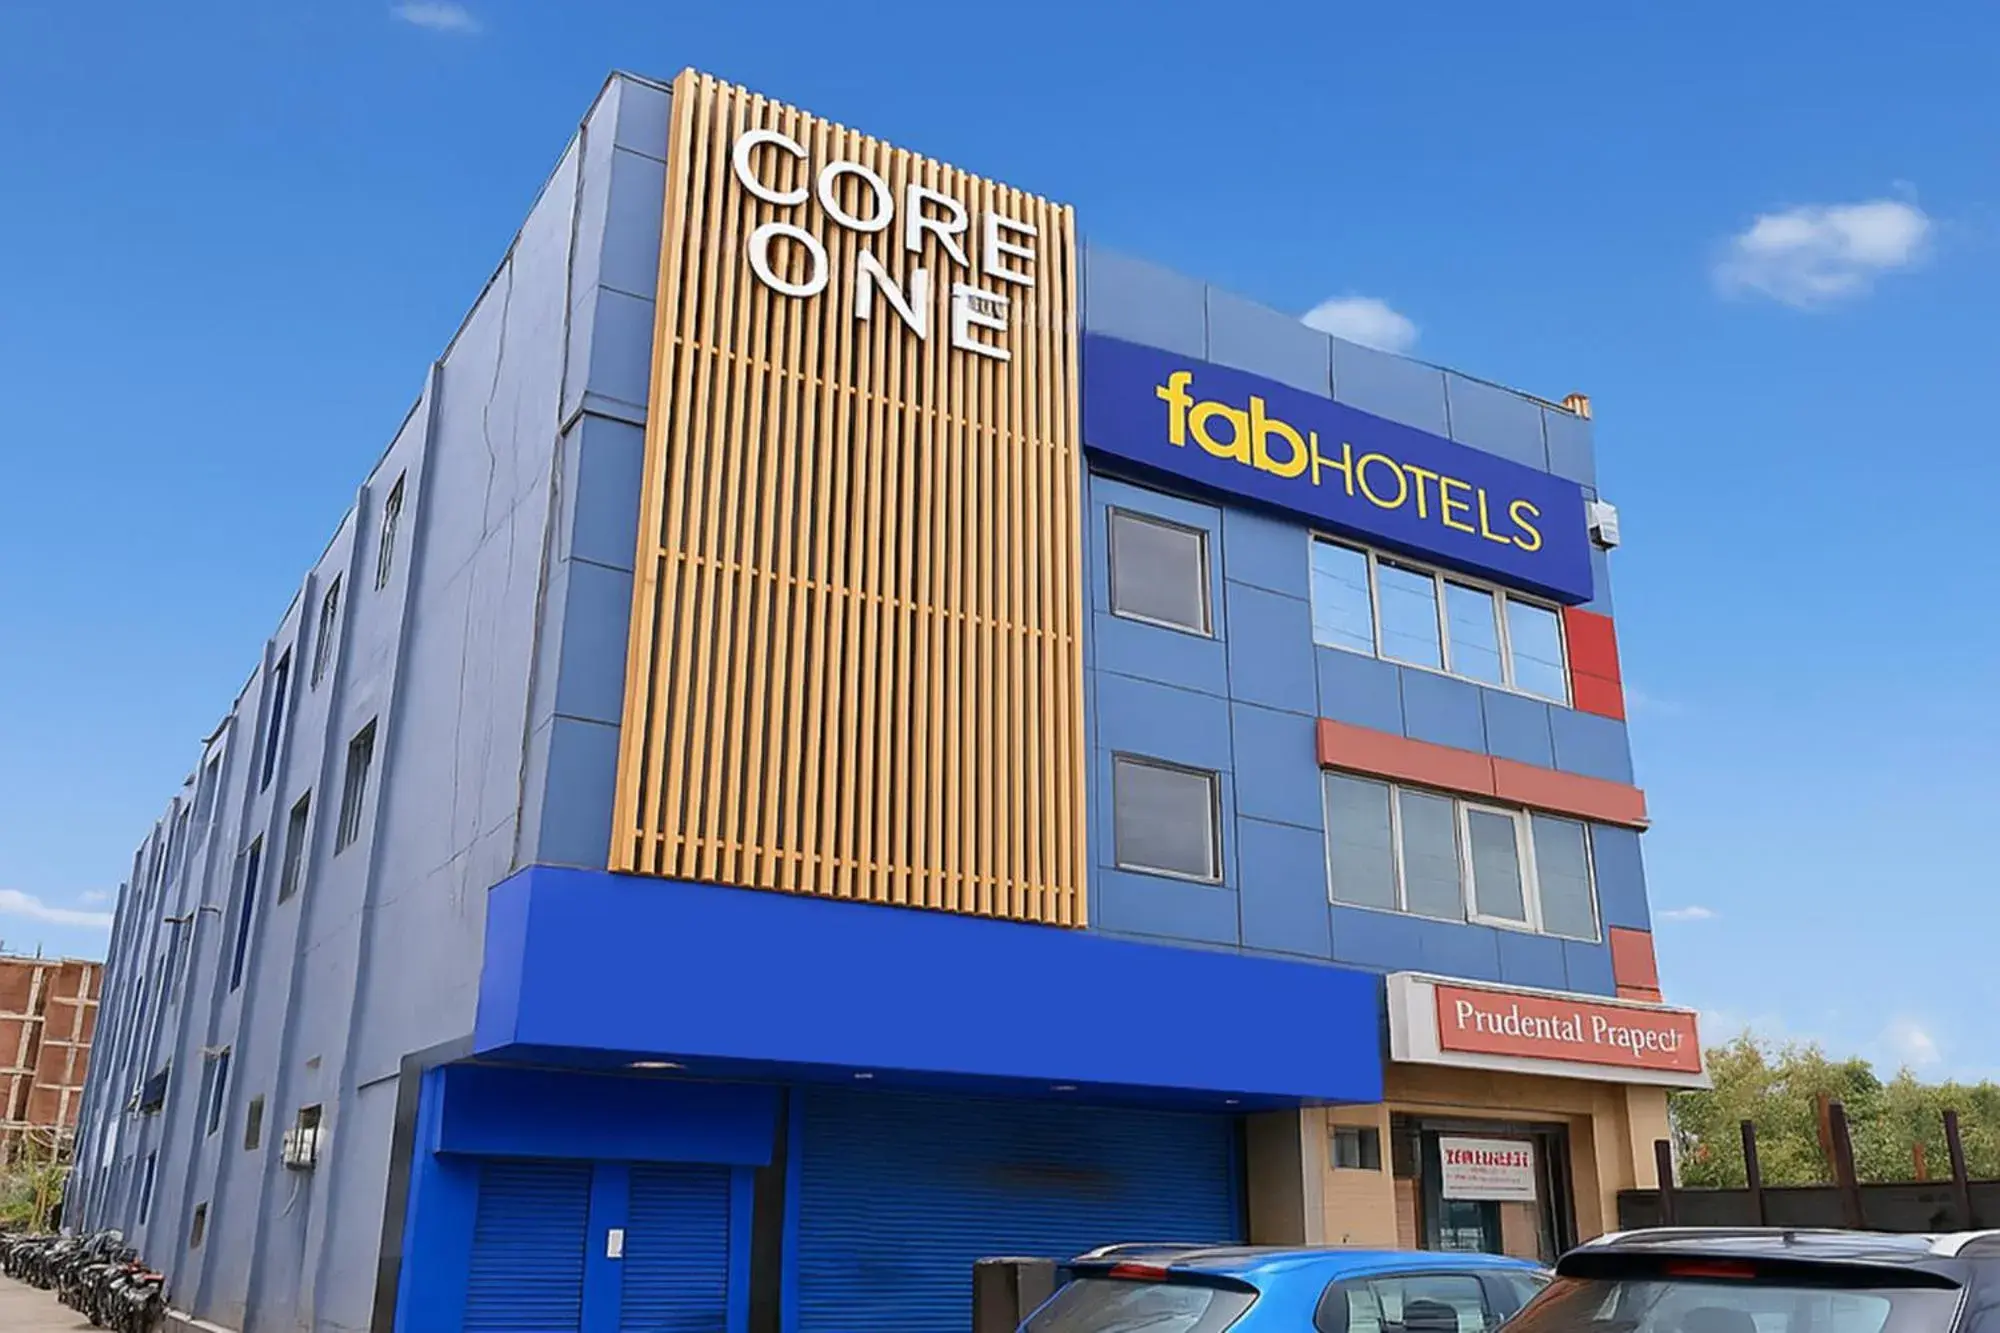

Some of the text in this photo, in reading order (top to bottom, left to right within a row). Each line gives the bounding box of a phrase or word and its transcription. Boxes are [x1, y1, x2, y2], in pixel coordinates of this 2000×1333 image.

[733, 129, 1038, 287] CORE
[748, 222, 1012, 361] ONE
[1455, 1000, 1584, 1042] Prudental
